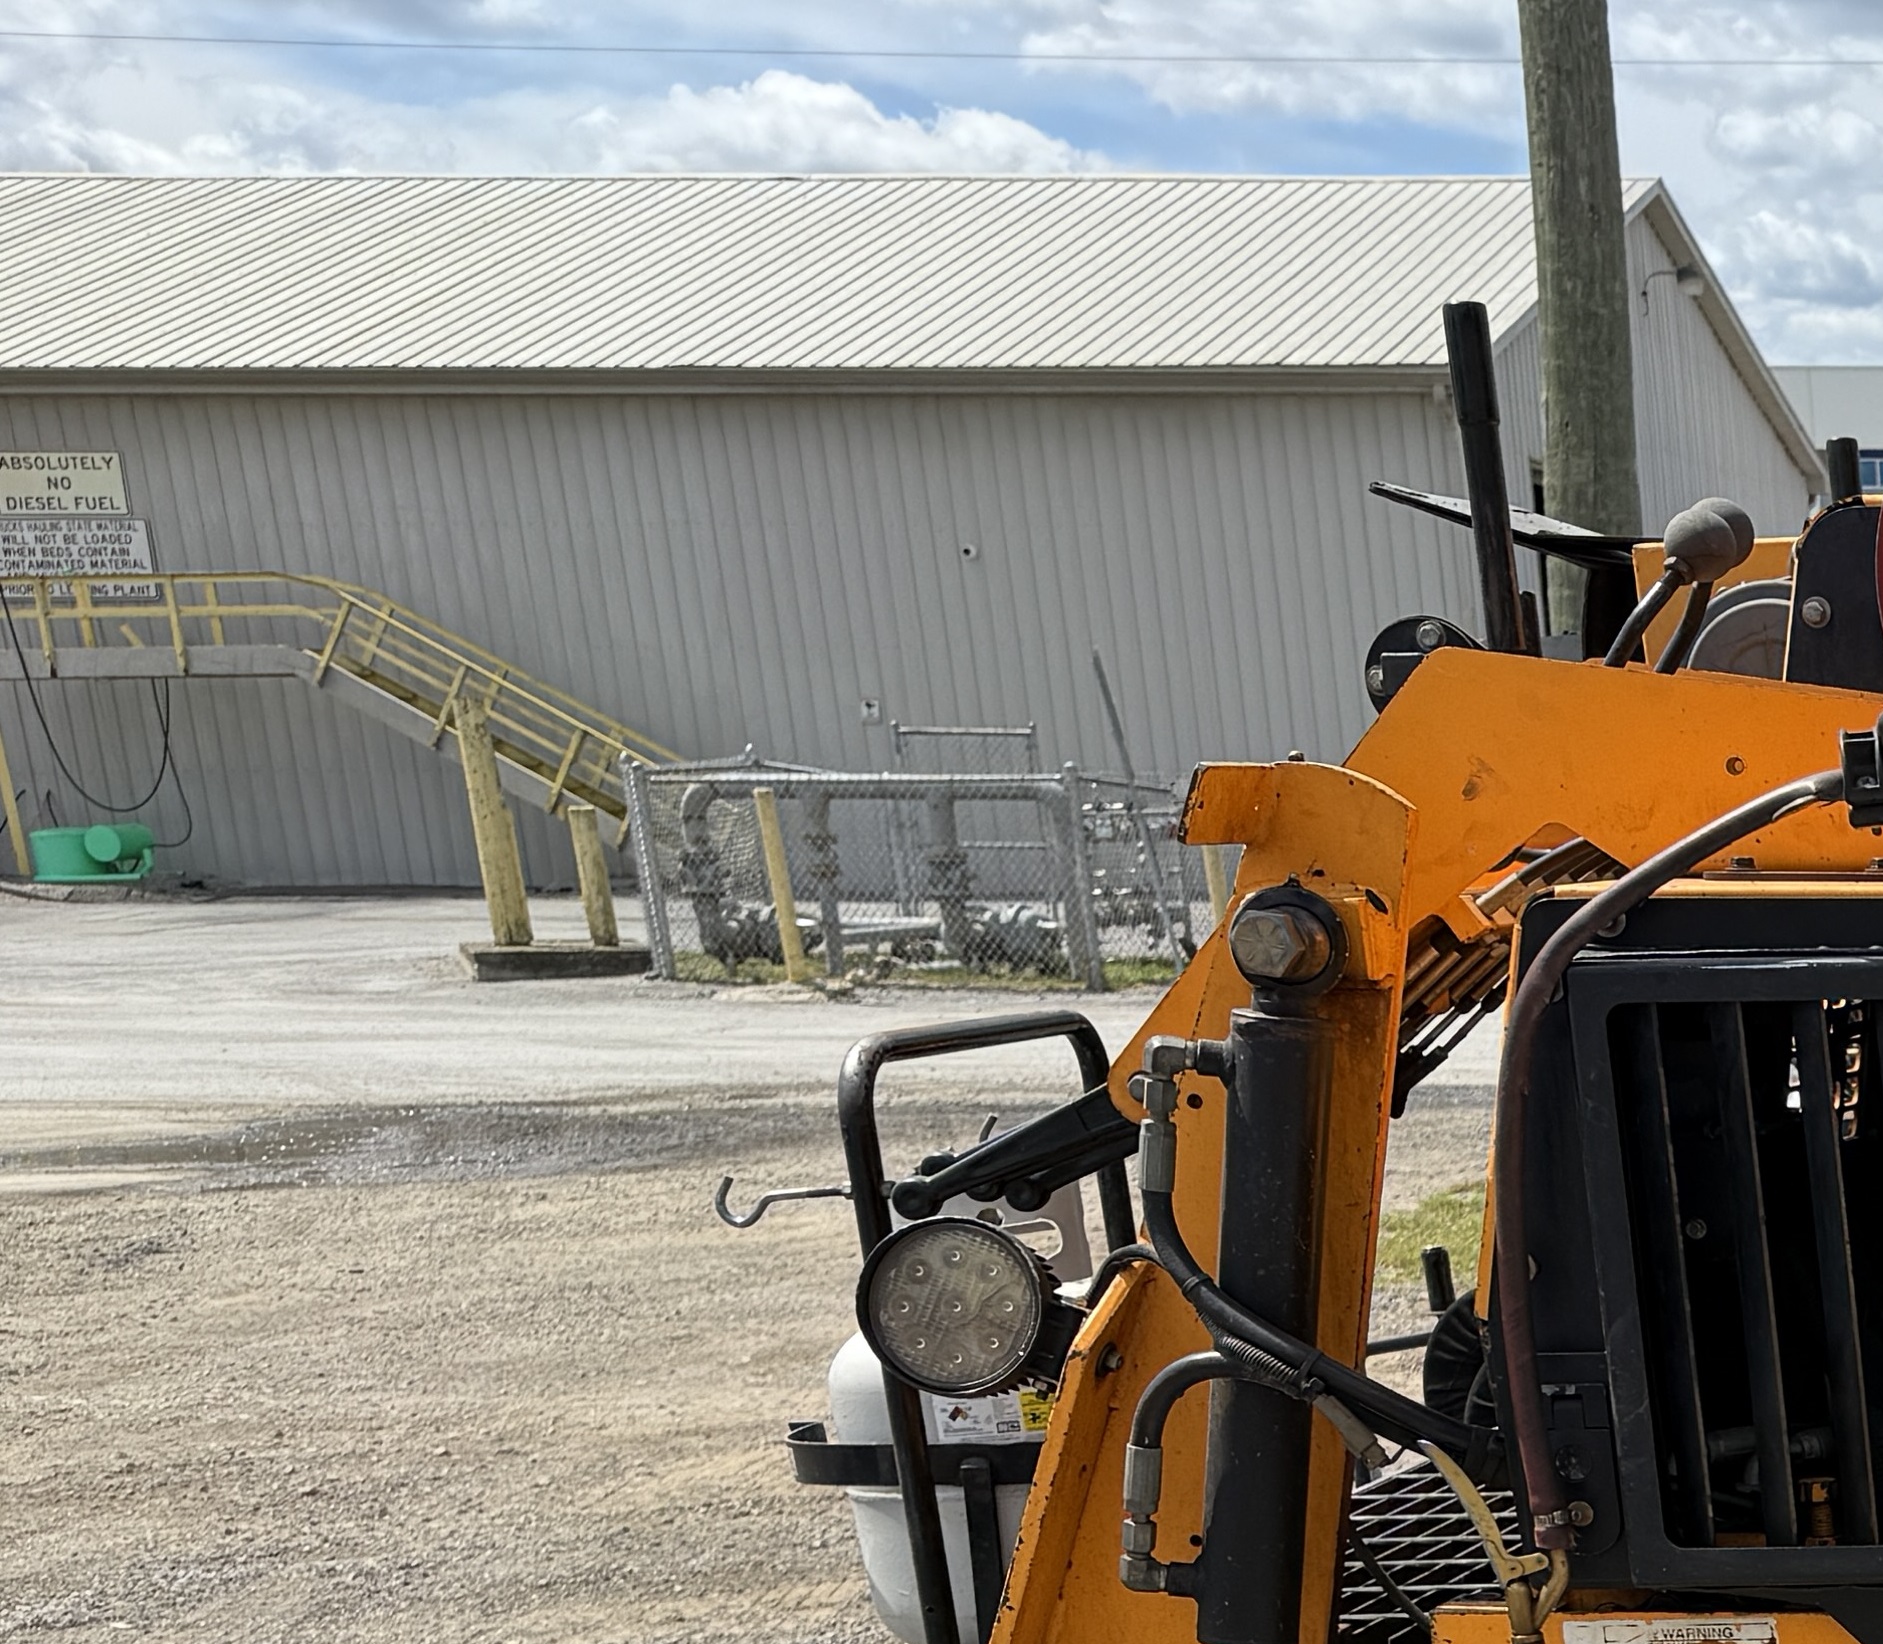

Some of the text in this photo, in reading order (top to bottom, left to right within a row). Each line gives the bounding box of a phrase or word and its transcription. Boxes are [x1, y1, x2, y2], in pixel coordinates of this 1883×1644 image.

[0, 456, 114, 471] ABSOLUTELY
[46, 476, 72, 490] NO
[6, 496, 121, 511] DIESEL FUEL
[1, 533, 133, 546] WILL NOT BE LOADED
[2, 546, 131, 558] WHEN BEDS CONTAIN
[0, 558, 148, 571] CONTAMINATED MATERIAL
[113, 583, 151, 596] PLANT
[1660, 1626, 1735, 1639] WARNING
